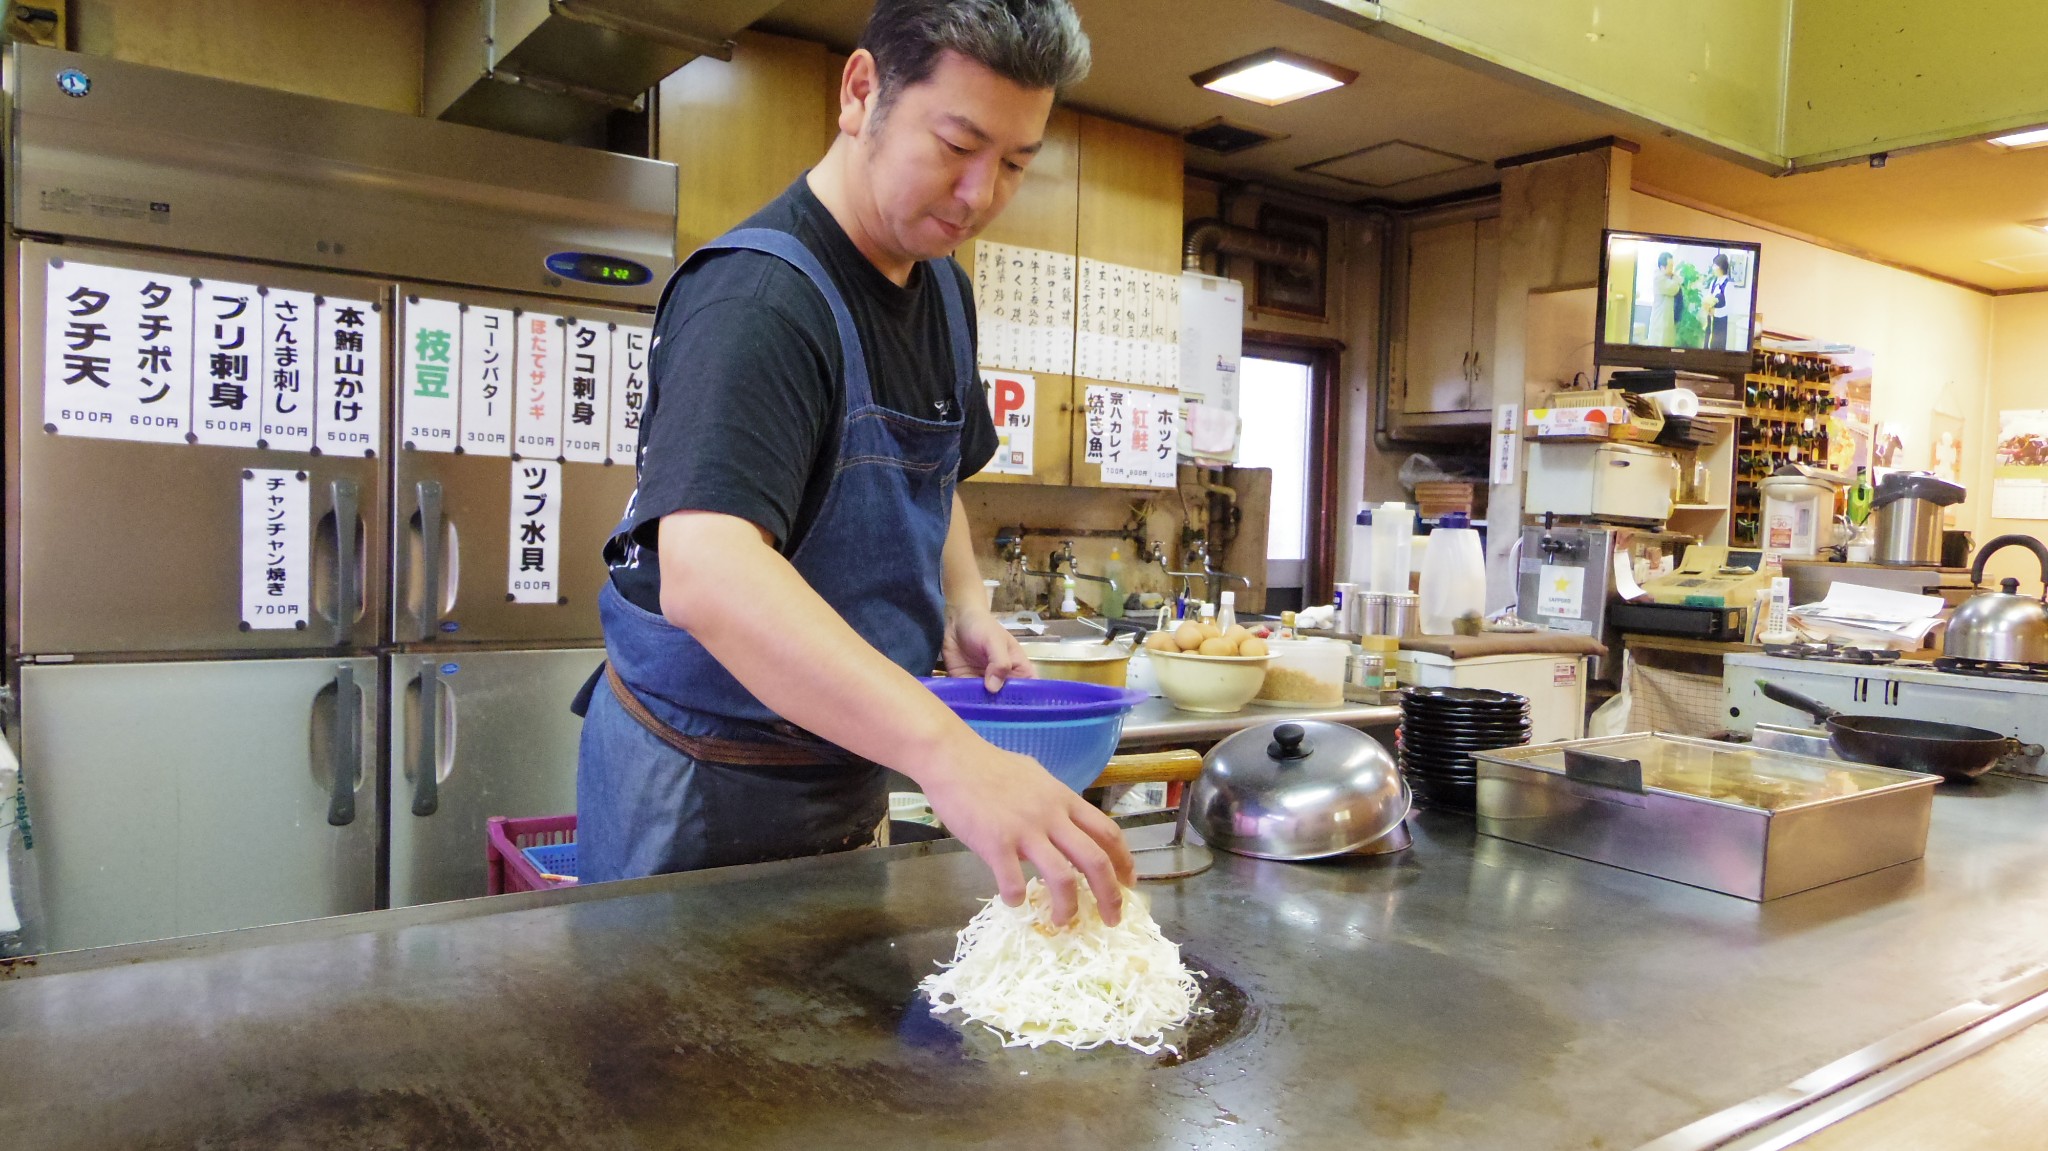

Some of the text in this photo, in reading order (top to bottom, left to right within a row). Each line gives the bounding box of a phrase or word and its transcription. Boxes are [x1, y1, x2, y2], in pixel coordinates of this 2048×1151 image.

[63, 286, 111, 388] タチ天
[137, 281, 173, 404] タチポン
[208, 295, 249, 410] ブリ刺身
[273, 300, 300, 414] さんま刺し
[334, 306, 365, 422] 本鮪山かけ
[414, 327, 451, 399] 枝豆
[482, 315, 499, 417] コーンバター
[529, 319, 546, 421] ほたてザンギ
[572, 326, 596, 426] タコ刺身
[625, 333, 643, 430] にしん切込
[61, 409, 112, 424] 600円
[130, 414, 179, 429] 600円
[205, 419, 251, 433] 500円
[994, 379, 1025, 427] P
[1008, 414, 1030, 427] 有り
[1088, 393, 1104, 457] 焼き魚
[1109, 392, 1123, 462] 宗ハカレイ
[264, 424, 308, 437] 600円
[327, 432, 370, 444] 500円
[411, 426, 451, 439] 350円
[467, 432, 505, 444] 300円
[518, 435, 555, 447] 400円
[565, 439, 600, 452] 700円
[1132, 408, 1148, 452] 紅鮭
[1157, 409, 1173, 459] ホッケ
[266, 477, 286, 596] チャンチャン焼き
[520, 467, 548, 572] ツブ水貝
[255, 604, 299, 615] 700円
[514, 580, 550, 591] 600円
